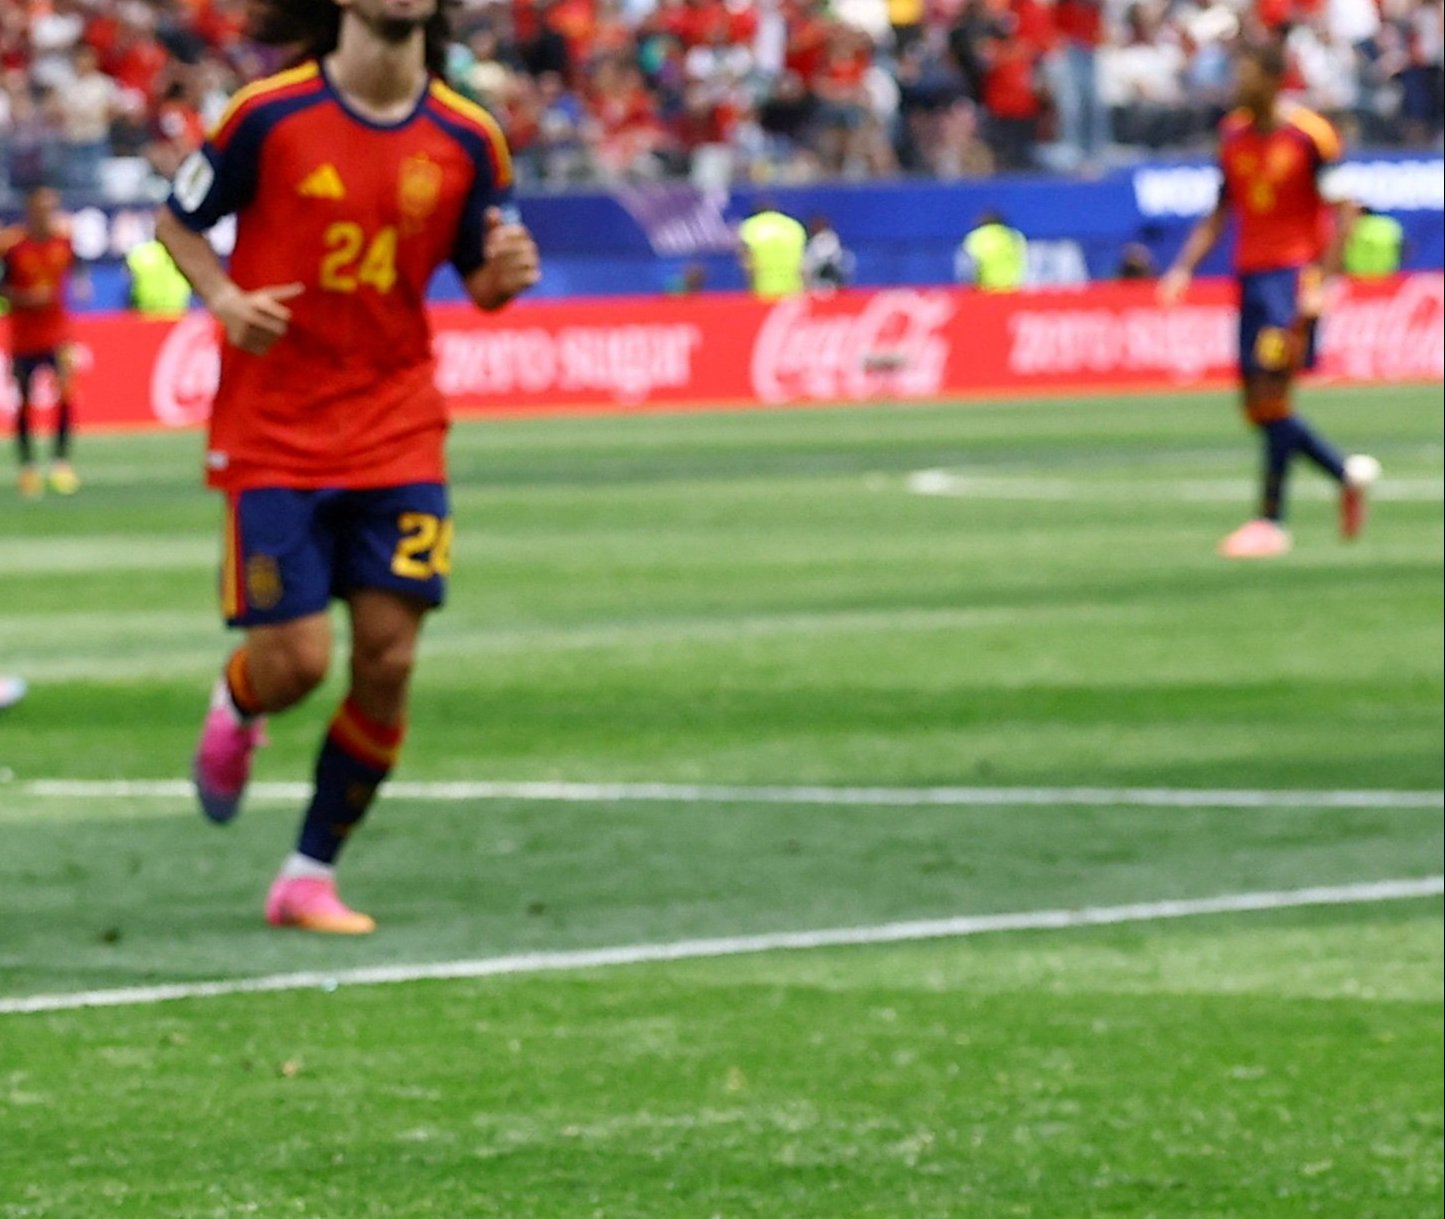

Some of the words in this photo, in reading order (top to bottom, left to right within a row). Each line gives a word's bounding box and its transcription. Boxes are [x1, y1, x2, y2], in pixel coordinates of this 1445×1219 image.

[320, 220, 399, 295] 24
[557, 323, 703, 407] sugar
[750, 289, 958, 404] Coca-Cola
